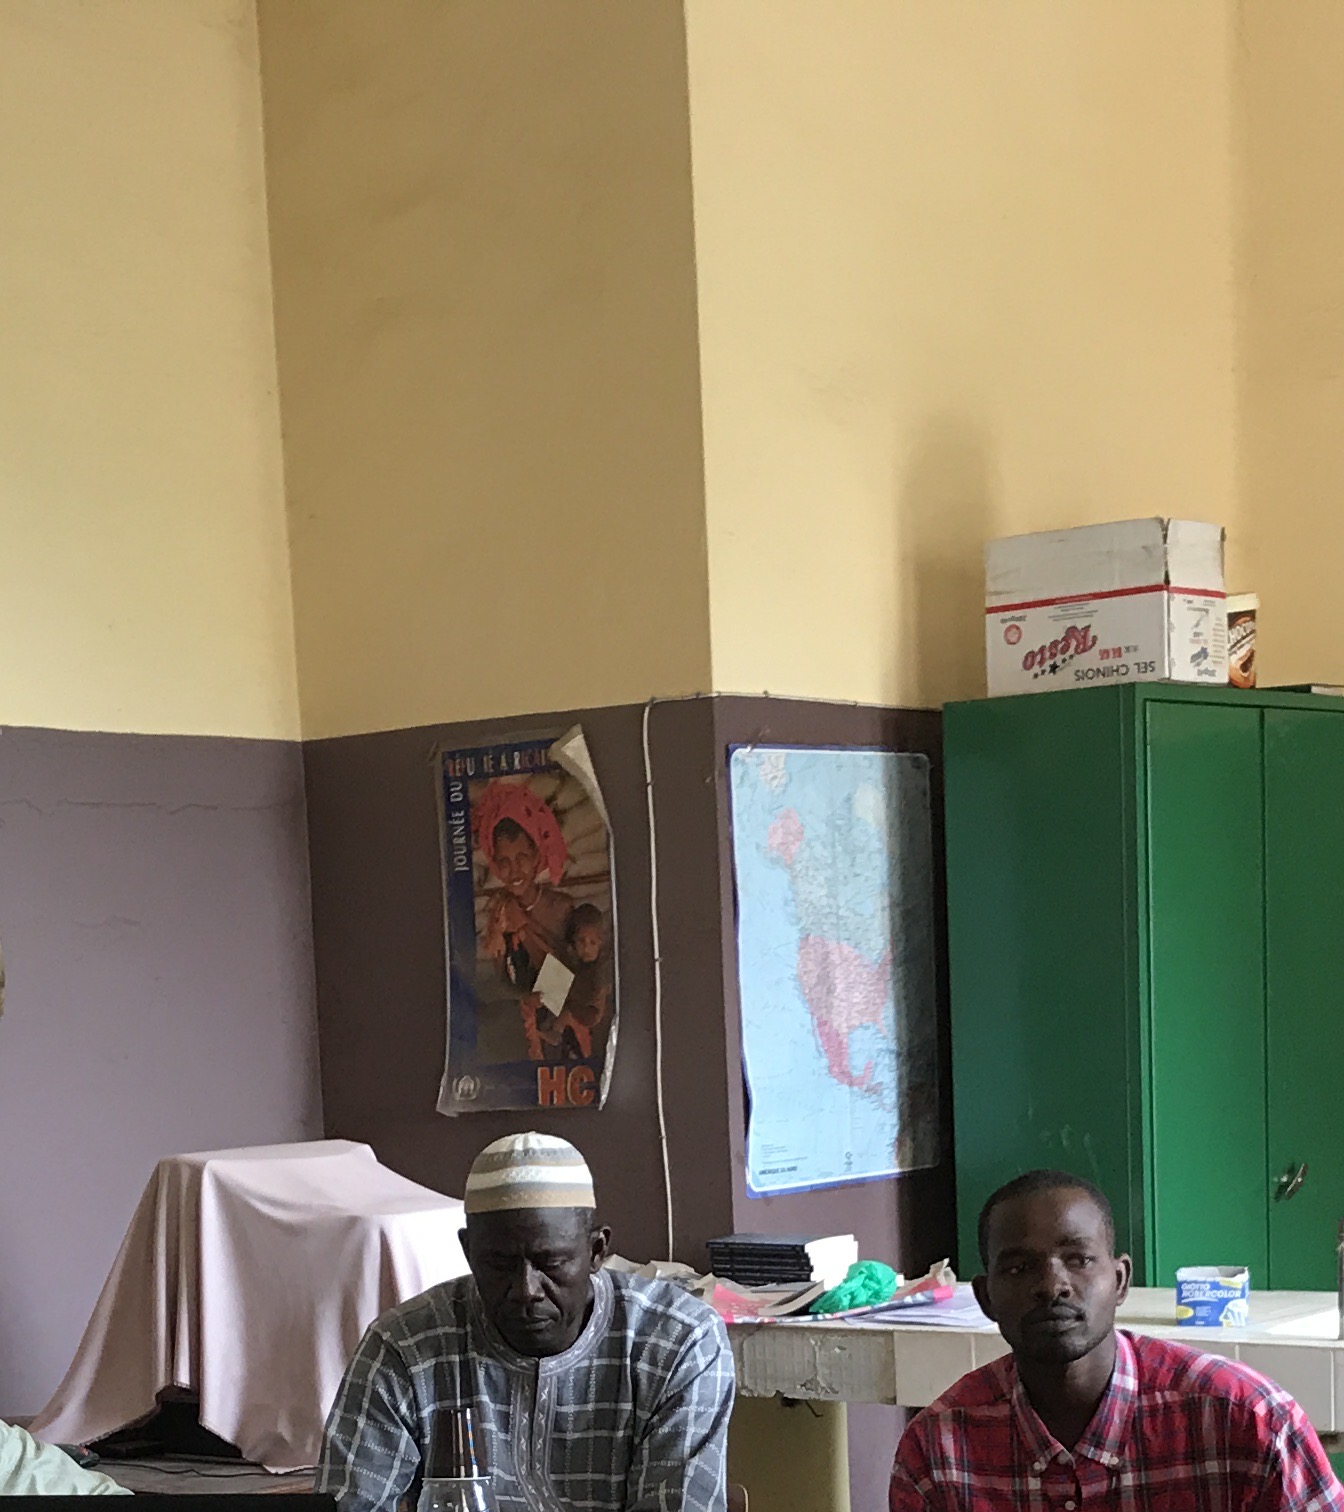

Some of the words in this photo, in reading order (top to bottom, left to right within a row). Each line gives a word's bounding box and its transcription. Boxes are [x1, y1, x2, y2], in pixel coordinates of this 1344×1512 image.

[1022, 624, 1098, 671] Resto
[1074, 664, 1130, 681] CHINOIS
[1134, 661, 1156, 674] SEL
[449, 781, 464, 802] DU
[448, 810, 470, 871] JOURNÉE
